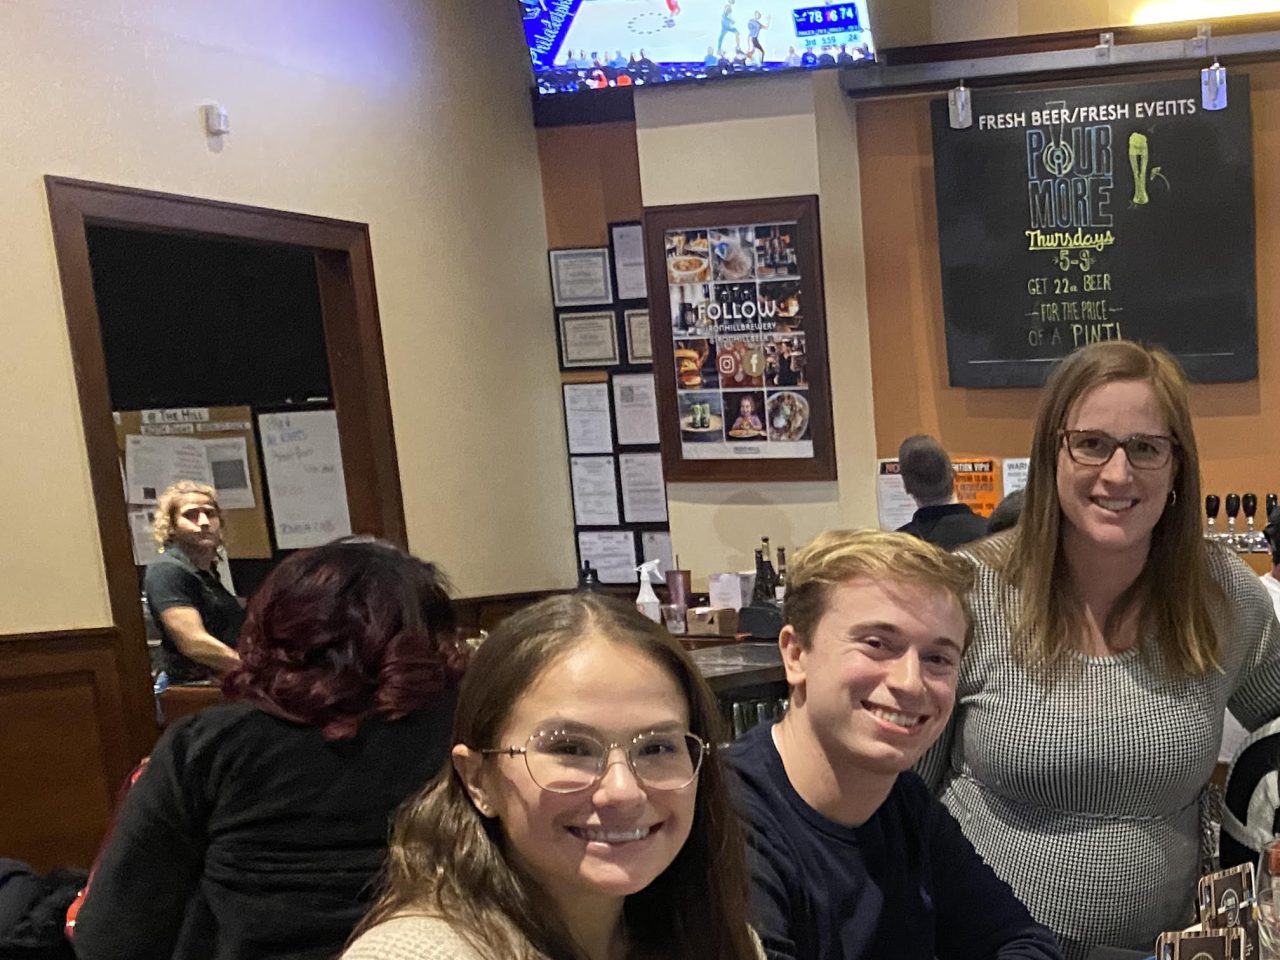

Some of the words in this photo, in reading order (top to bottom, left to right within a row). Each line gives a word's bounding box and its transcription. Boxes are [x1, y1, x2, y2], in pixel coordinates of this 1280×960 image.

[808, 11, 823, 23] 78
[839, 6, 854, 19] 74
[979, 112, 1025, 130] FRESH
[1031, 104, 1129, 127] BEER/FRESH
[1135, 99, 1196, 119] EVENTS
[1026, 125, 1114, 179] POUR
[1028, 177, 1114, 229] MORE
[1025, 228, 1115, 250] Thursdays
[1027, 278, 1048, 295] GET
[1083, 273, 1111, 292] BEER
[697, 300, 776, 321] FOLLOW
[1040, 302, 1059, 321] FOR
[1062, 301, 1079, 320] THE
[1080, 299, 1108, 321] PRICE
[1028, 329, 1044, 347] OF
[1051, 328, 1061, 344] A
